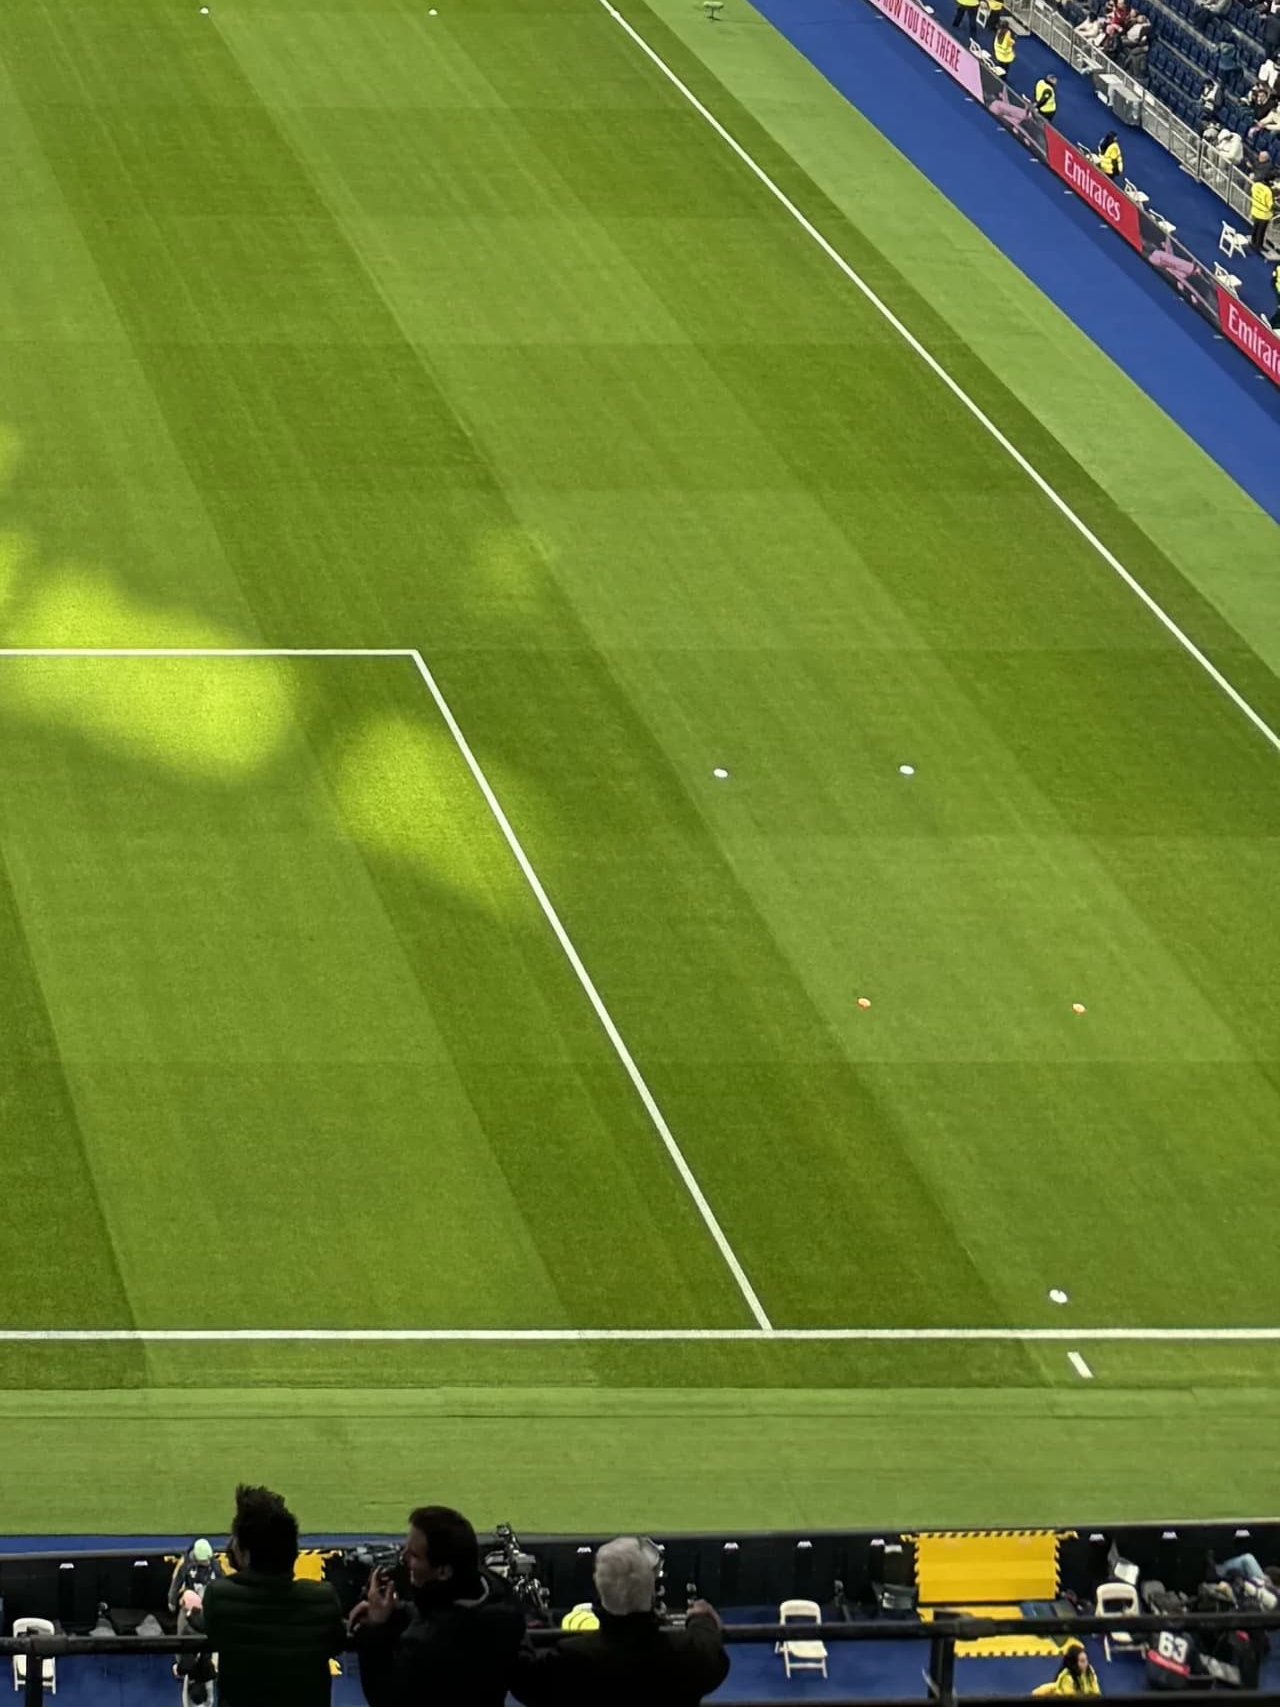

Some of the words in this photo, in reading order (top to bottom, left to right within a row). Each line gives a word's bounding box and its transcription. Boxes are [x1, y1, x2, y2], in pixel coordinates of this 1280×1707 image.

[903, 2, 919, 34] YOU
[919, 17, 935, 49] GET
[935, 29, 962, 73] THERE
[1063, 149, 1122, 222] Emirates
[1157, 1630, 1189, 1665] 63
